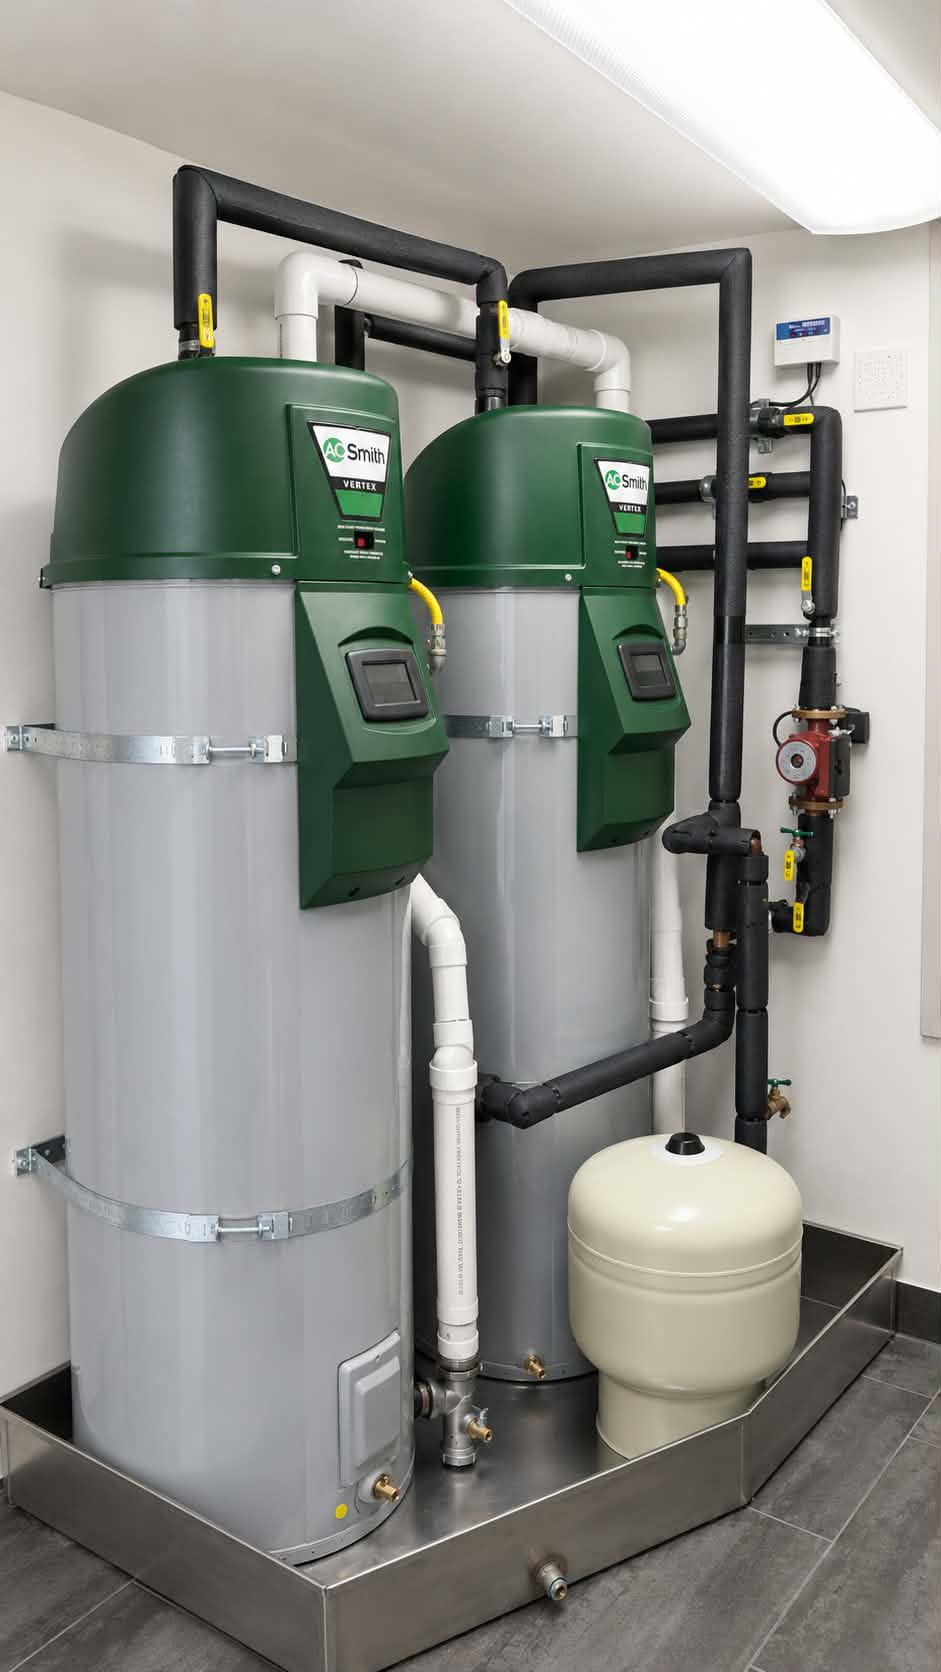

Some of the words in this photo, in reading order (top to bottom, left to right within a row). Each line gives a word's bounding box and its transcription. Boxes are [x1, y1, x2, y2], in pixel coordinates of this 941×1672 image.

[347, 443, 385, 464] Smith
[343, 480, 377, 491] VERTEX
[622, 474, 648, 490] Smith
